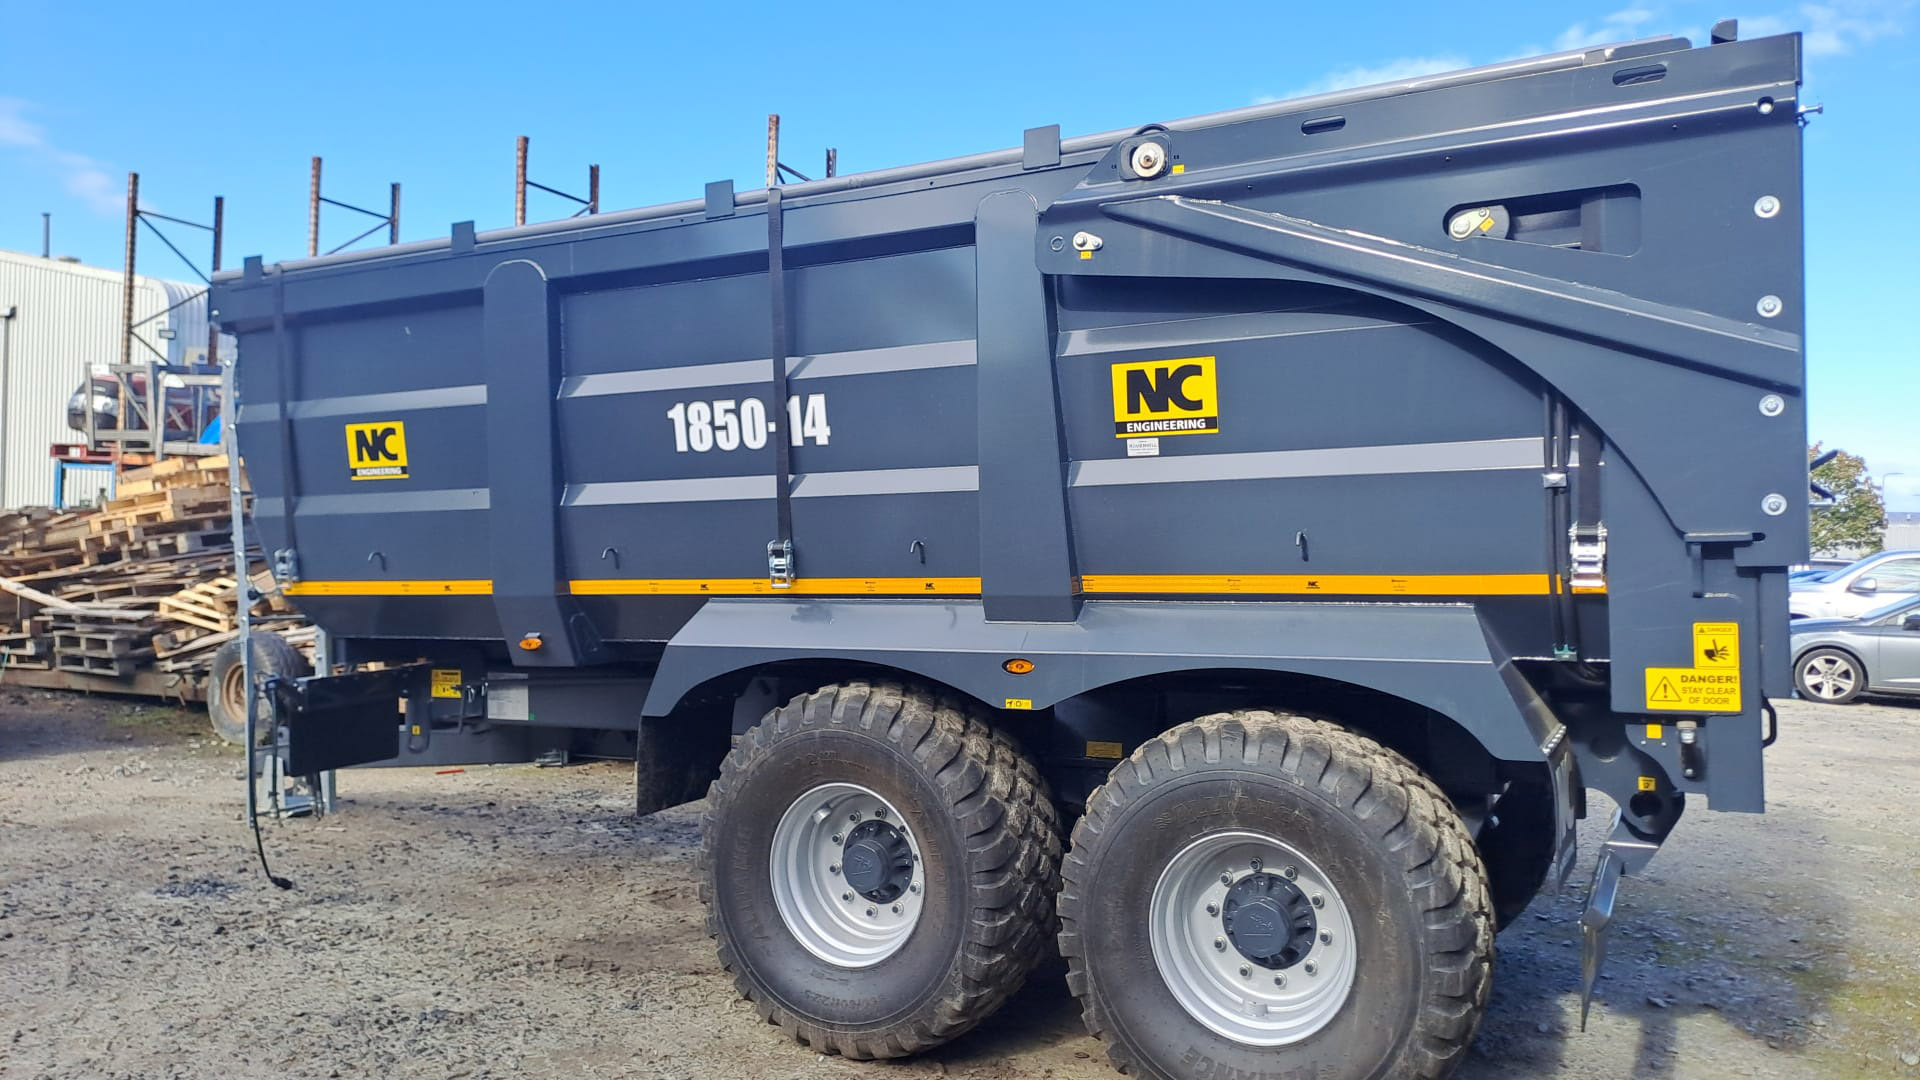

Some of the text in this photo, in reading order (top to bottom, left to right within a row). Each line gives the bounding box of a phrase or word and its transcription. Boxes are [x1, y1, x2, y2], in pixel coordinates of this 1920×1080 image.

[1126, 364, 1203, 414] NC
[1126, 418, 1207, 433] ENGINEERING
[355, 427, 398, 462] NC
[1680, 674, 1737, 684] DANGER!
[1681, 686, 1736, 695] STAY CLEAR
[1688, 696, 1730, 705] OF DOOR
